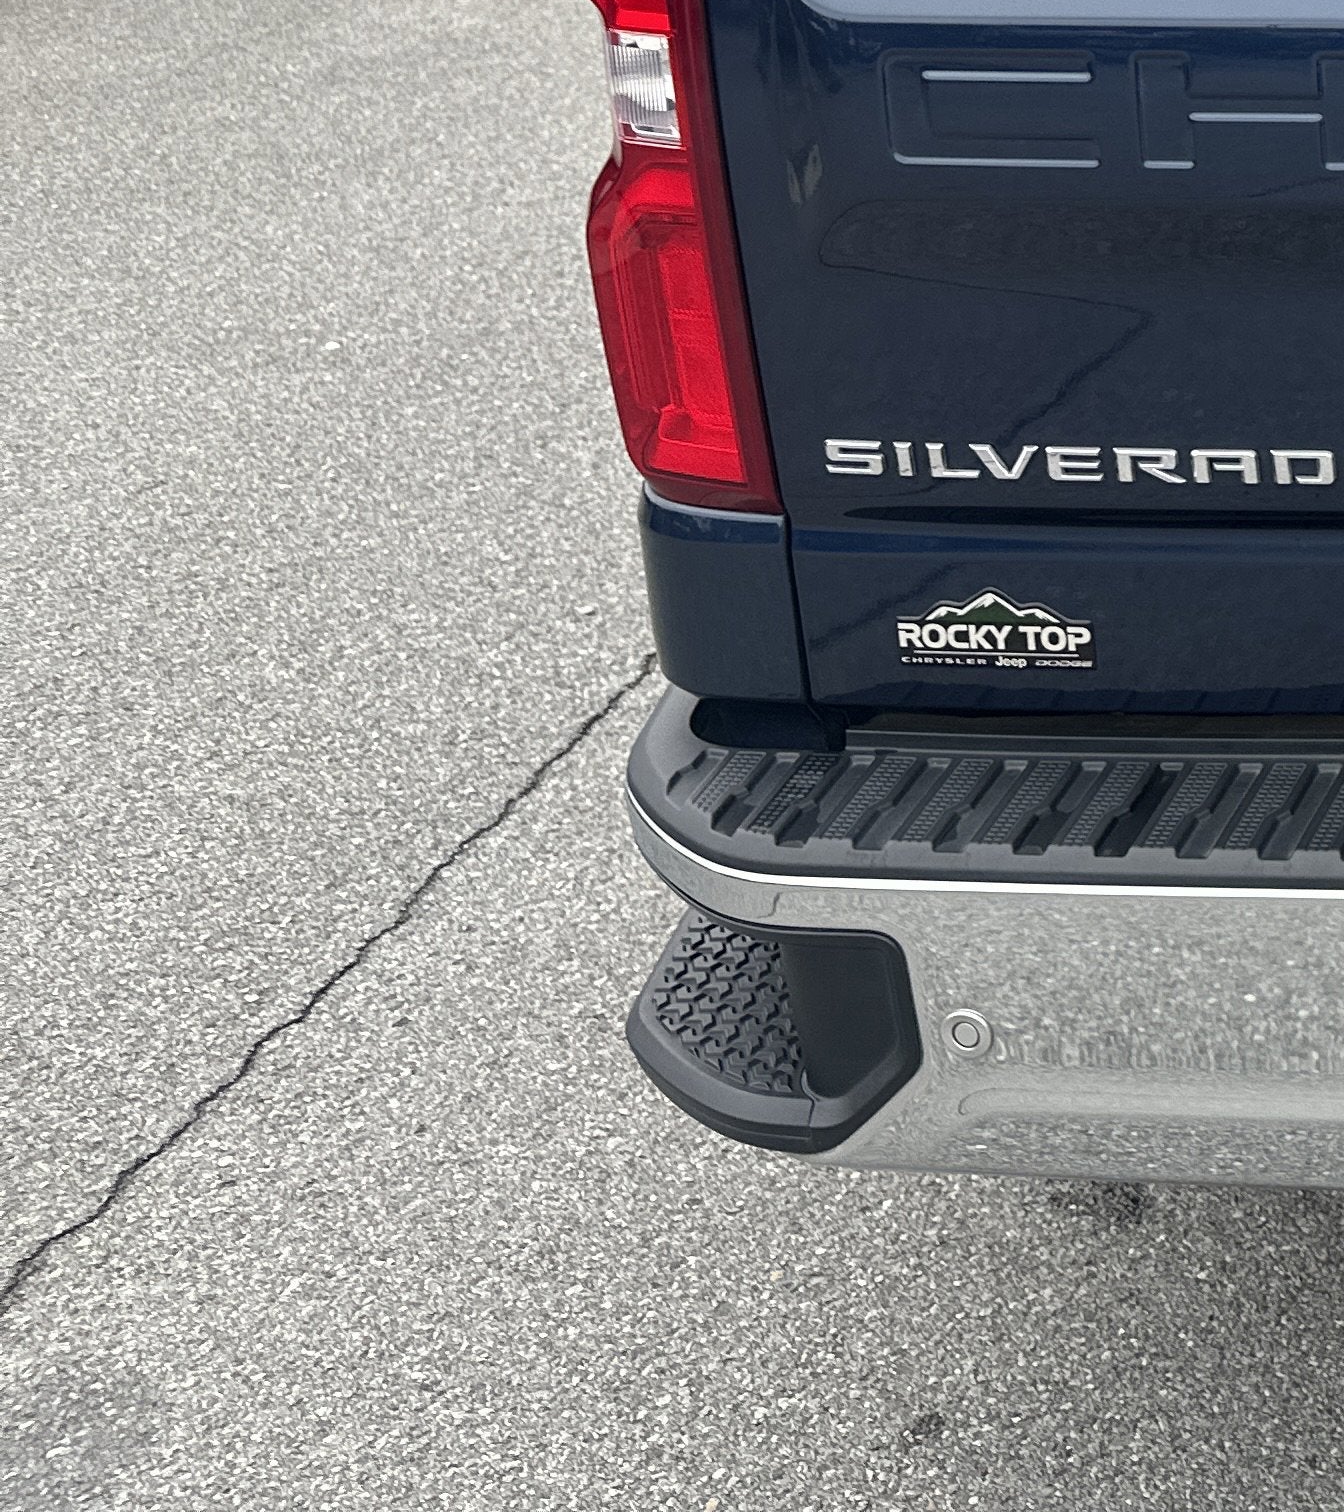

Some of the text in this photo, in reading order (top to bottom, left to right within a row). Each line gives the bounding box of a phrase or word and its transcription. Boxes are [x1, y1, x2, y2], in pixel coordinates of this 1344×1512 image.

[897, 622, 1092, 652] ROCKY TOP
[901, 656, 1093, 669] CHRYSLER Jeep DODGE
